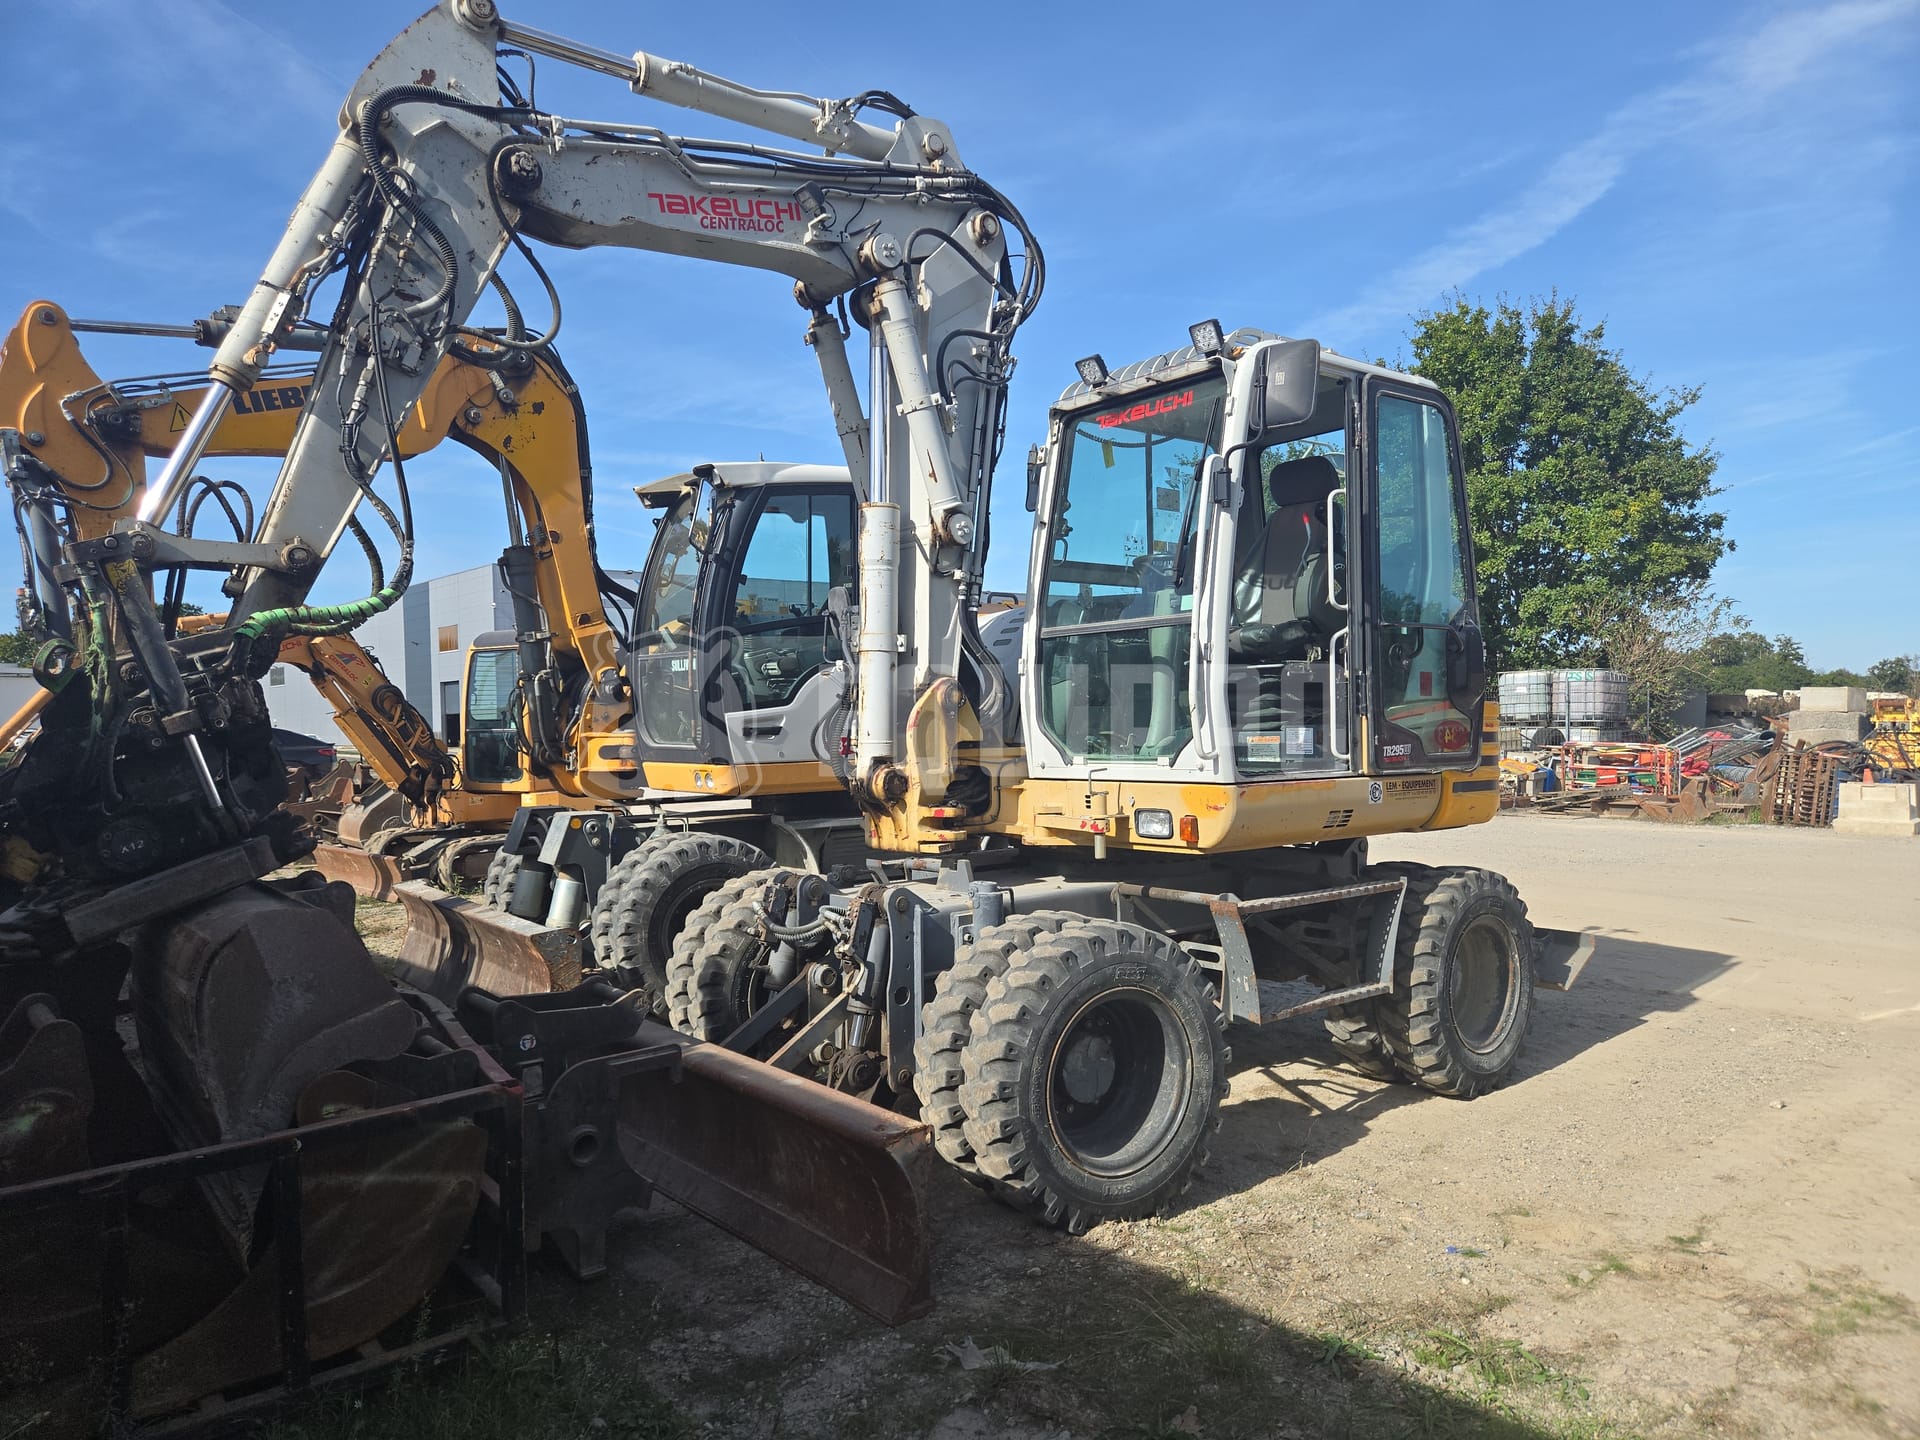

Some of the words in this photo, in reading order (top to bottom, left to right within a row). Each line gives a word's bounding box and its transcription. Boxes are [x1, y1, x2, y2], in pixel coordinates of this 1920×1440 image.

[700, 215, 785, 233] CENTRALOC
[1386, 780, 1398, 790] LEM
[1401, 779, 1436, 790] EQUIPEMENT
